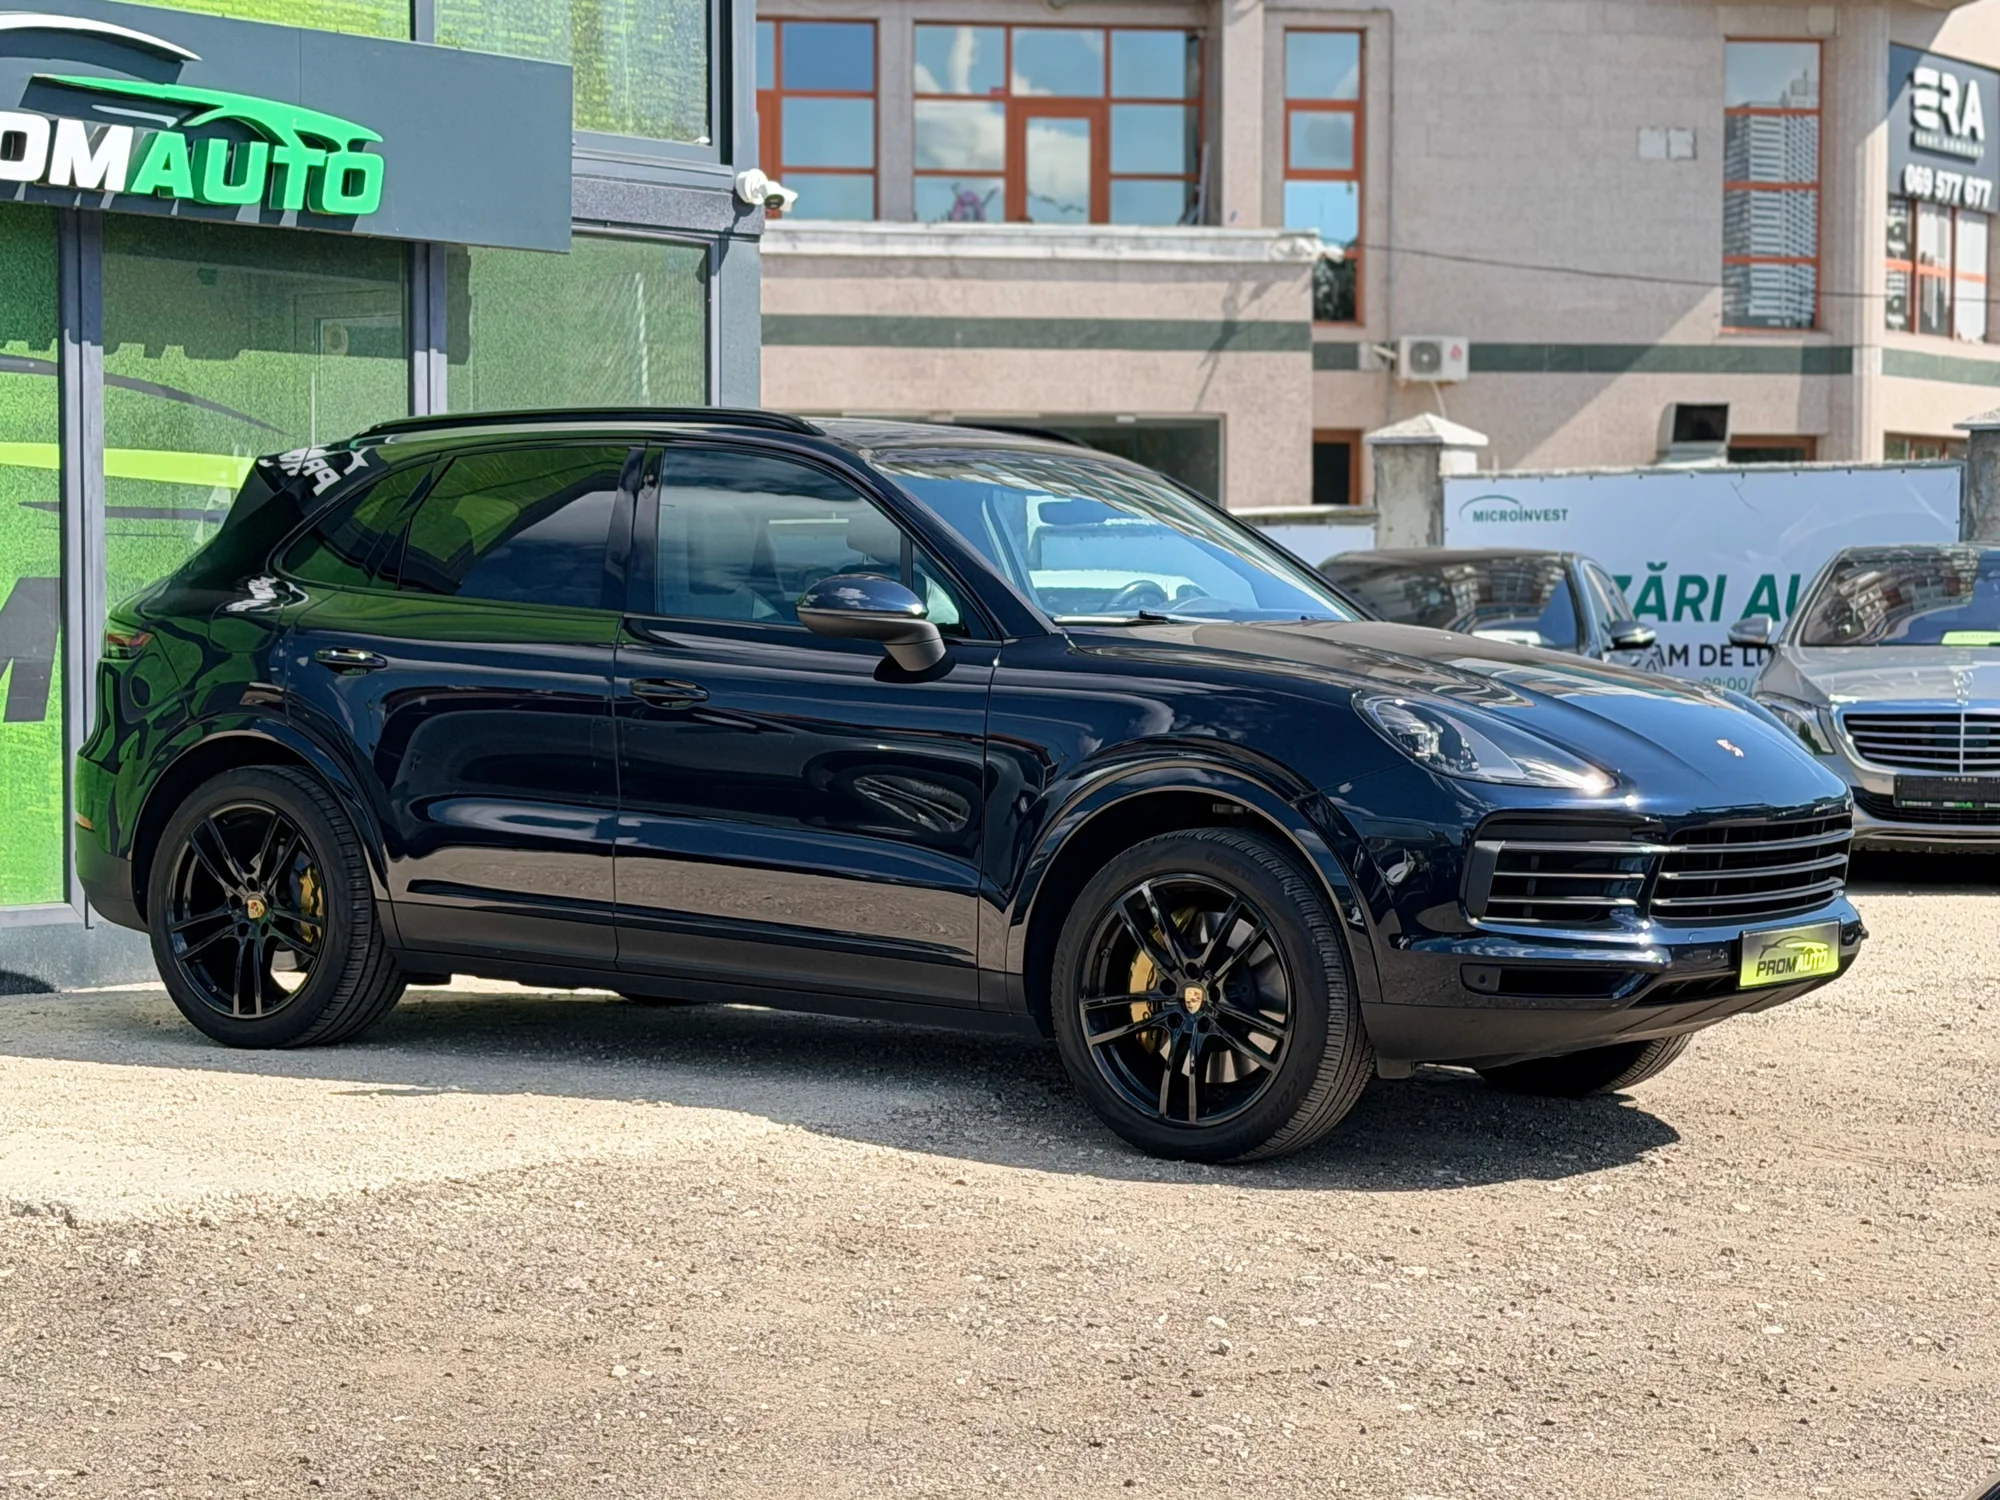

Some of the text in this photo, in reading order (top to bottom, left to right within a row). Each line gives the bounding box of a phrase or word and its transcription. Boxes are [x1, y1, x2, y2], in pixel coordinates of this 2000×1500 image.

[1914, 66, 1985, 141] ERA
[1904, 163, 1993, 209] 069 577 677
[1699, 644, 1733, 667] DE
[1756, 946, 1829, 977] PROMAUTO
